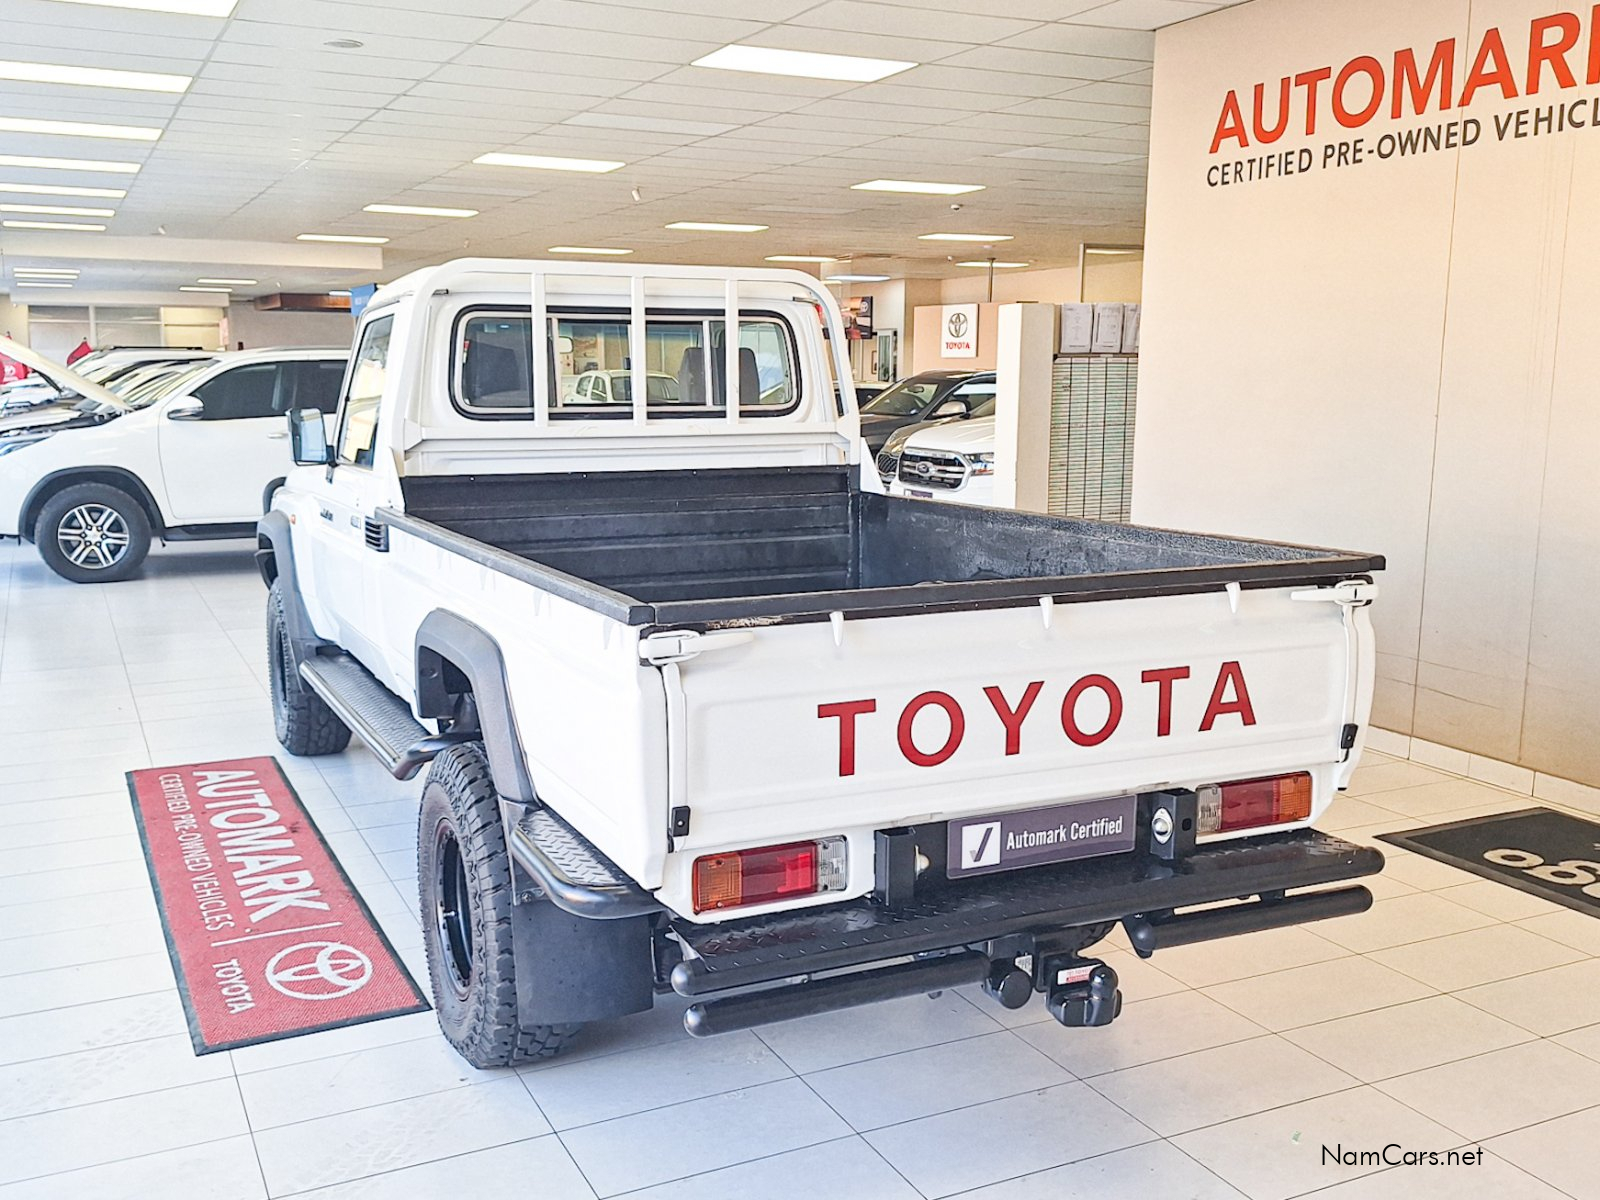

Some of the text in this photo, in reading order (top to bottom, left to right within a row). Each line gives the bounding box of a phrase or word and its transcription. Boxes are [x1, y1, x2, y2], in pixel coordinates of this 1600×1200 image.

[1209, 4, 1600, 154] AUTOMAR
[1206, 148, 1312, 188] CERTIFIED
[1322, 118, 1481, 169] PRE-OWNED
[945, 341, 970, 350] TOYOTA
[818, 661, 1256, 777] TOYOTA
[158, 773, 235, 931] CERTIFIED PRE-OWNED VEHICLES
[192, 770, 331, 924] AUTOMARK
[1006, 815, 1123, 850] Automark Certified
[212, 958, 256, 1014] TOYOTA
